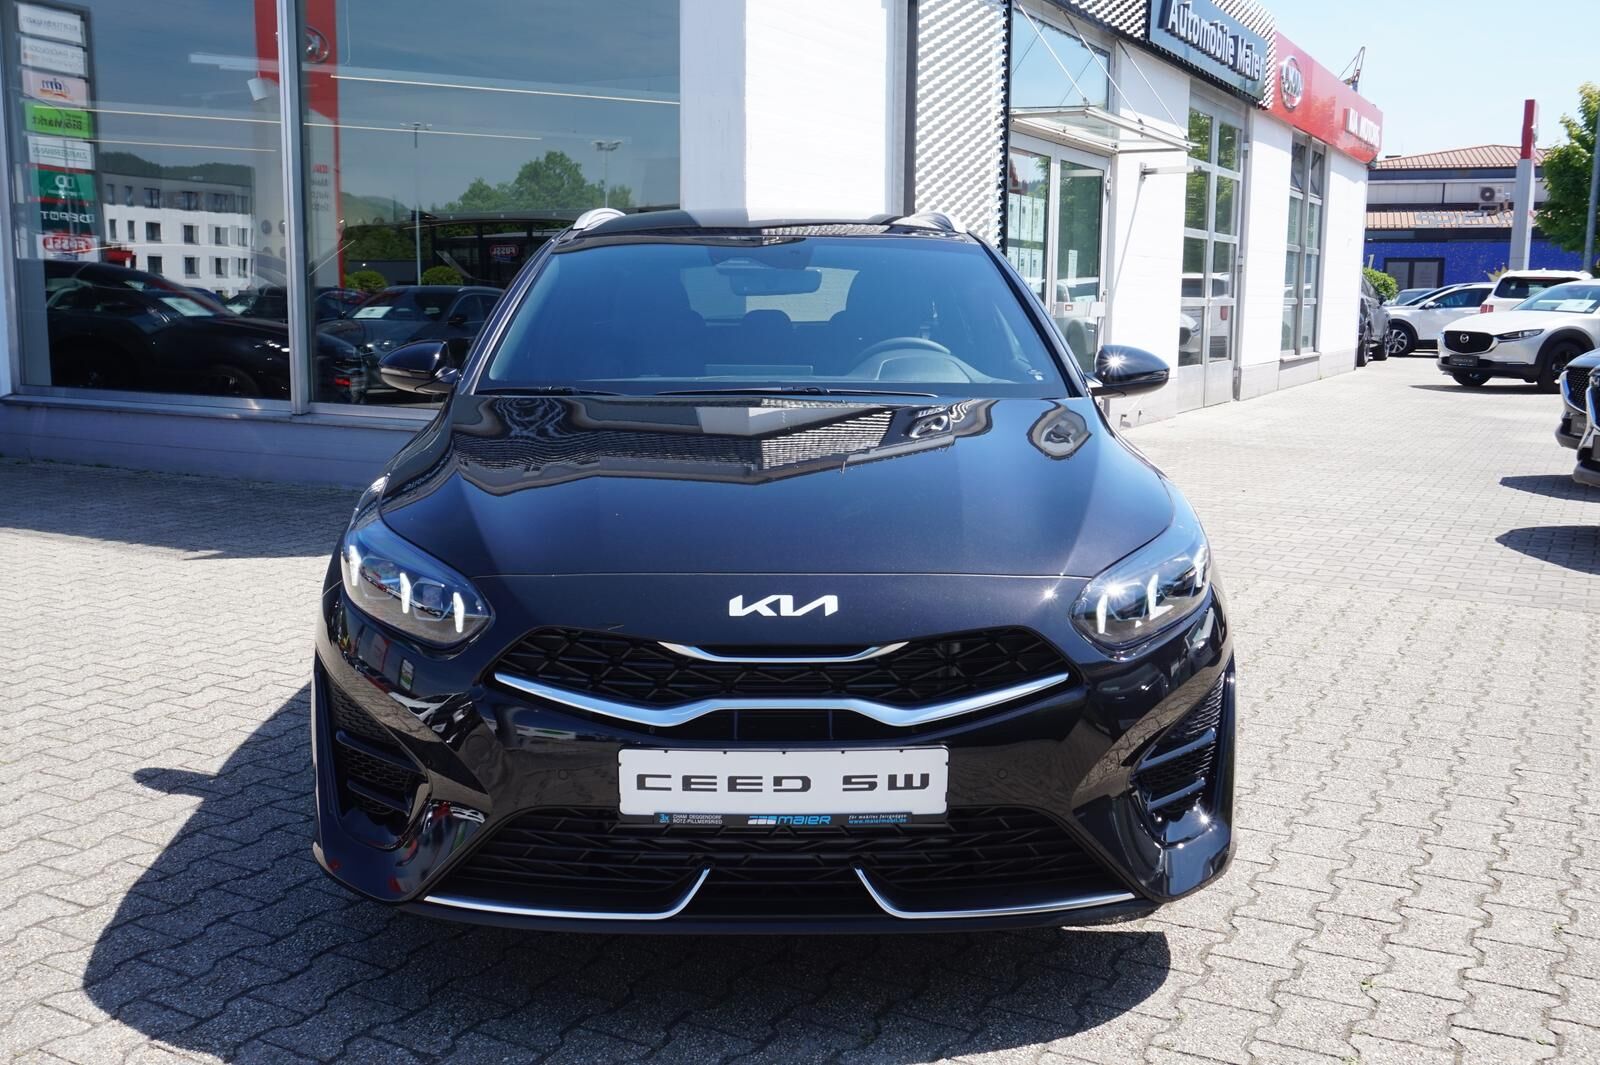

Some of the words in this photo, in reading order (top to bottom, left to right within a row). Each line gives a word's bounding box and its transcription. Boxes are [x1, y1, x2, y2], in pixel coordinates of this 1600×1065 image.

[1168, 0, 1235, 65] Automobile
[1237, 35, 1264, 81] Maier
[729, 594, 838, 617] KIA
[636, 773, 812, 793] CEED
[842, 773, 930, 792] SW
